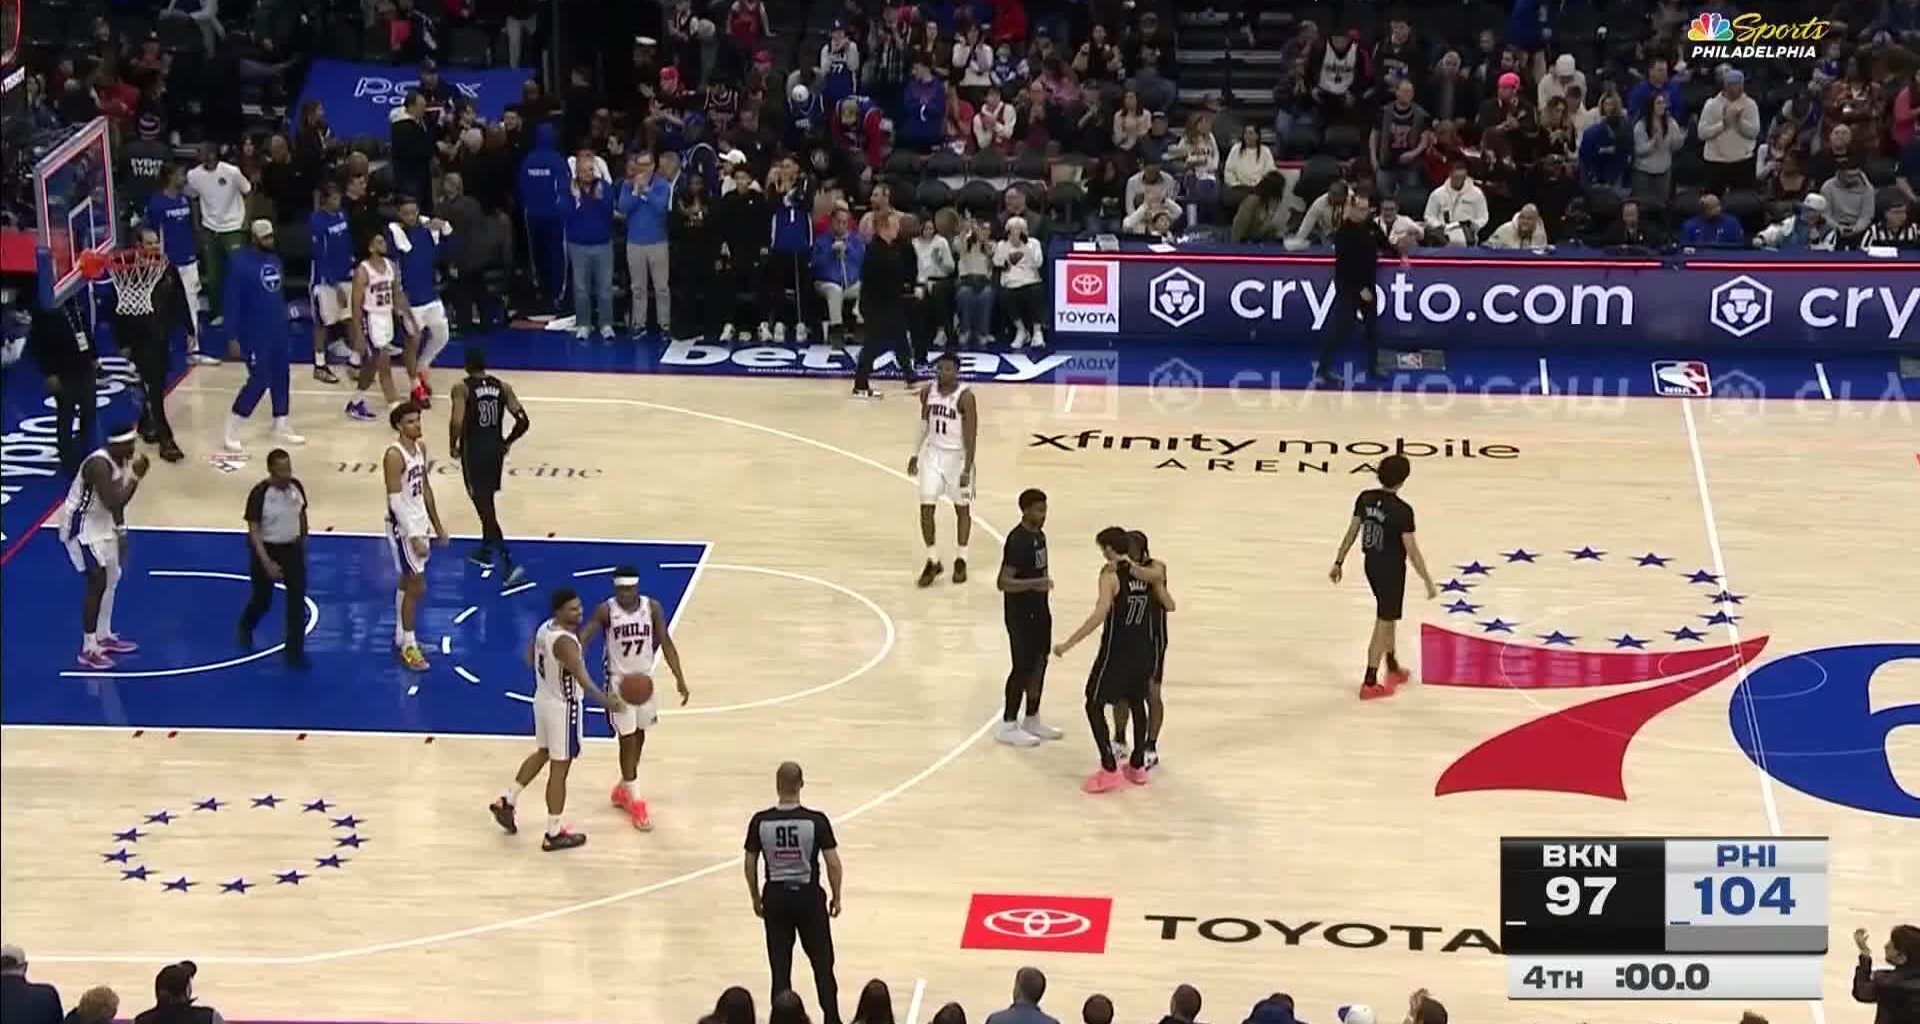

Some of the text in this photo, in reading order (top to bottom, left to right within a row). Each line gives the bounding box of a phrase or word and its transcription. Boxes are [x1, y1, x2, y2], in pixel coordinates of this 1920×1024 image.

[1229, 271, 1634, 331] cryto.com
[1057, 312, 1117, 324] TOYOTA
[659, 339, 1073, 381] betway
[478, 400, 499, 427] 31
[935, 419, 947, 434] 11
[1029, 430, 1521, 460] xfinity mobile
[1155, 458, 1380, 474] ARENA
[1125, 595, 1148, 626] 77
[613, 622, 650, 640] PHILA
[621, 639, 645, 658] 77
[775, 825, 800, 848] 95
[1144, 914, 1502, 955] TOYOTA
